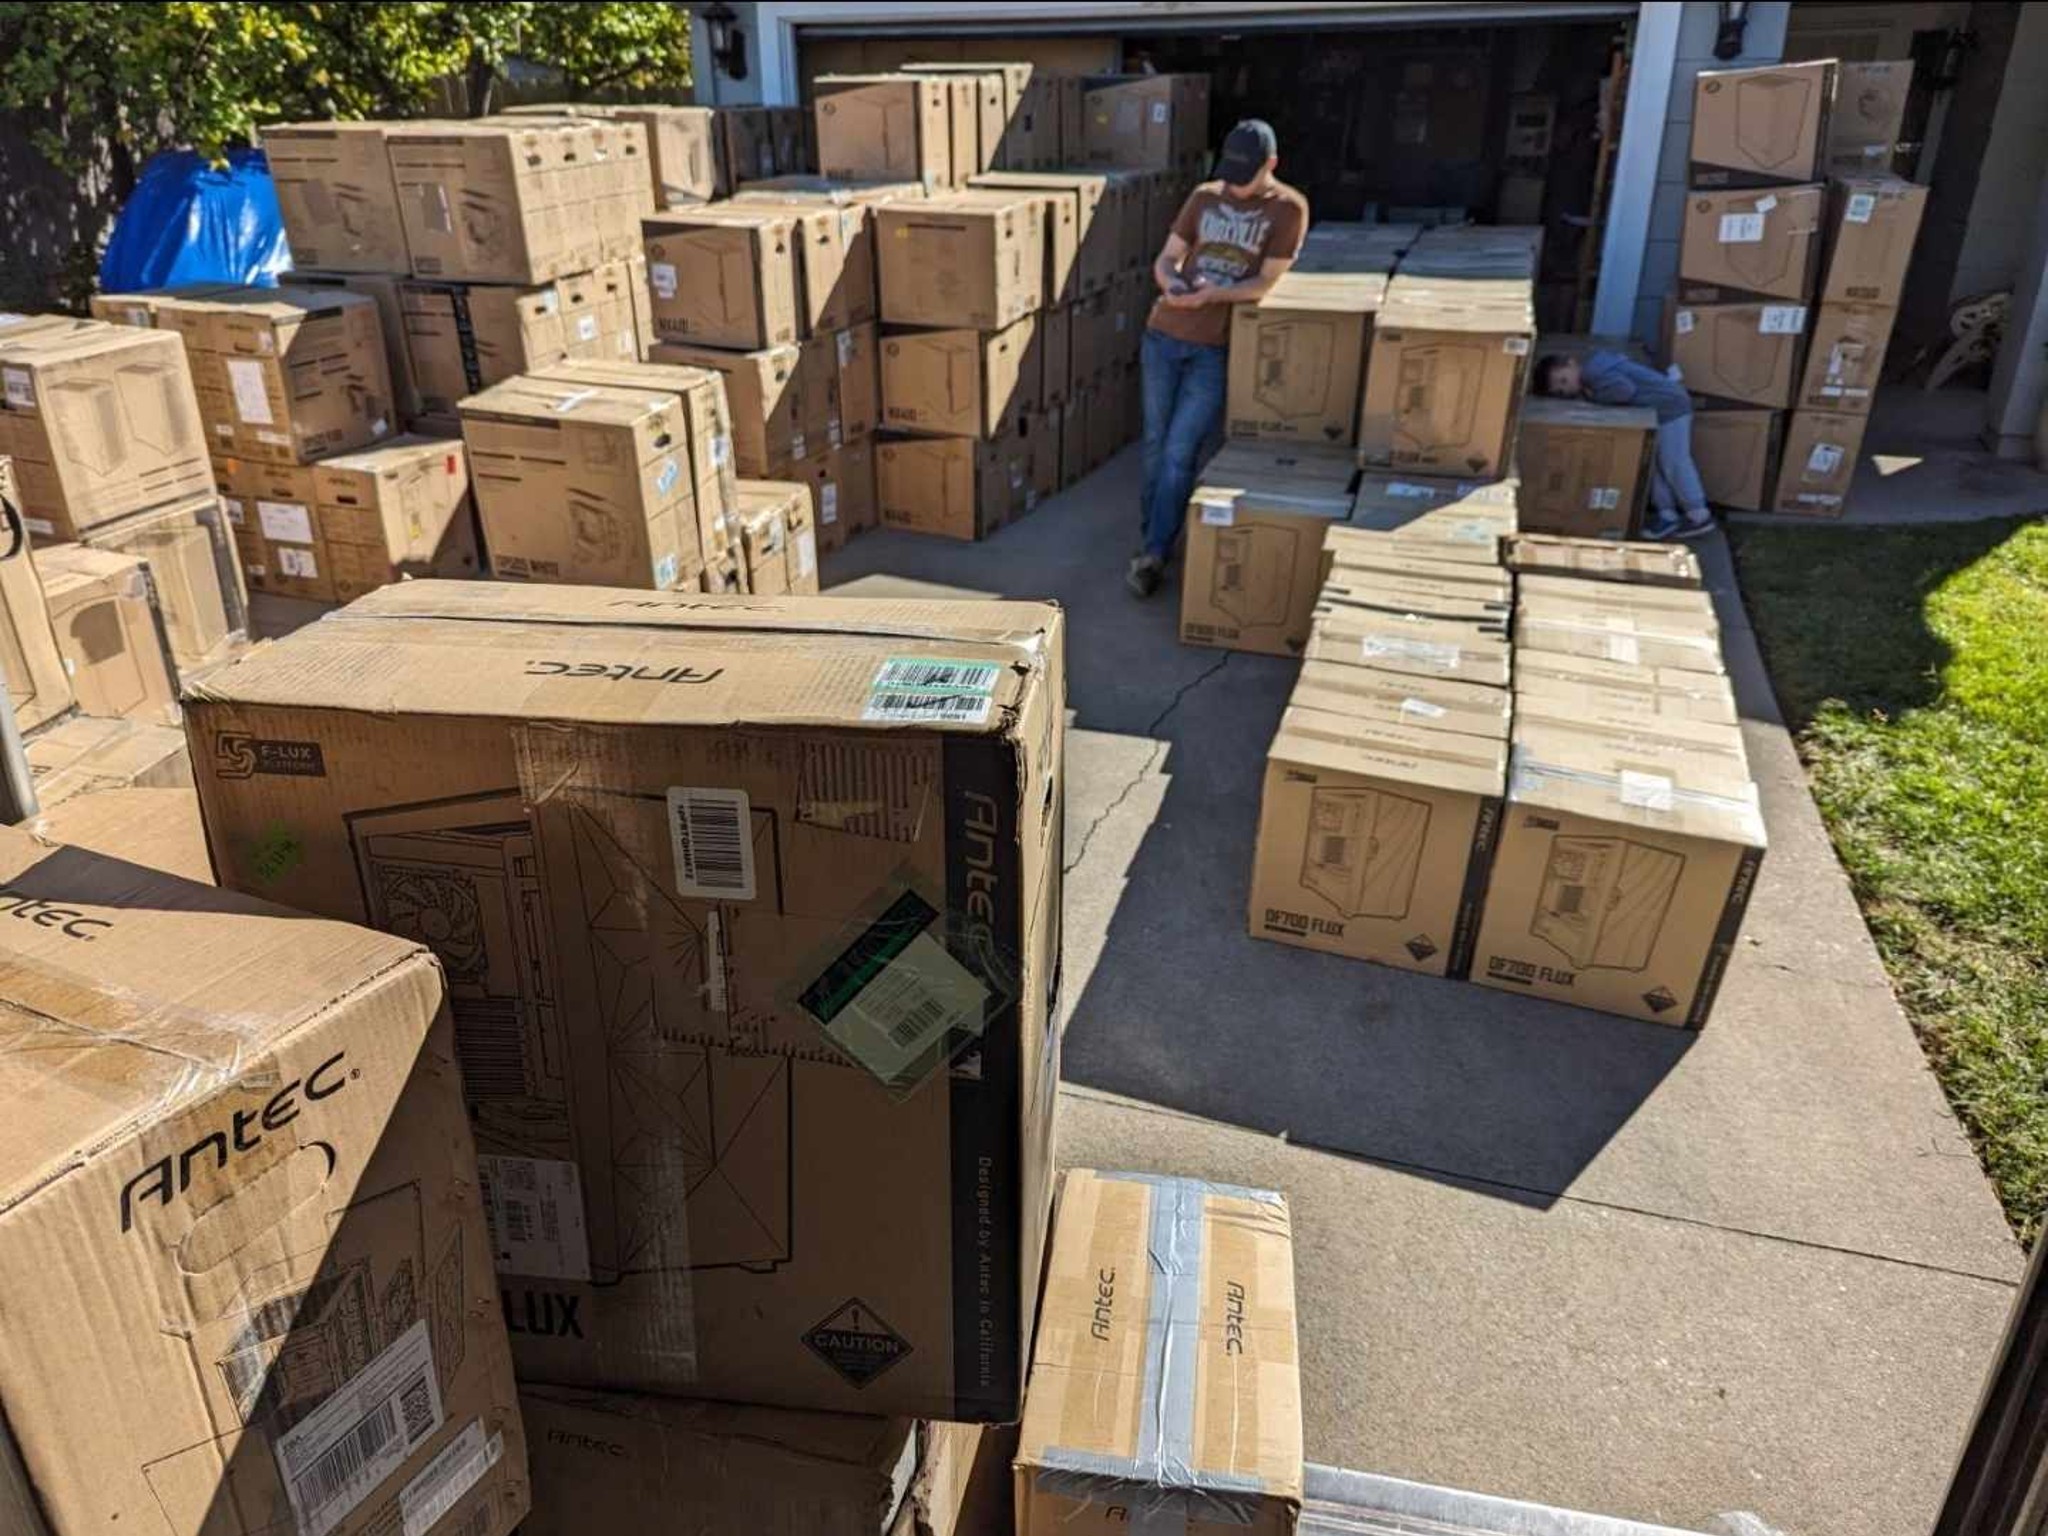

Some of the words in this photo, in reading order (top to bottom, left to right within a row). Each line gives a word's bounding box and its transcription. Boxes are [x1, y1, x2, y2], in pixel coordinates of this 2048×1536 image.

[523, 660, 725, 684] Antec
[963, 789, 998, 956] Antec
[1312, 918, 1345, 937] FLUX
[1540, 966, 1575, 986] FLUX
[118, 1049, 346, 1235] Antec
[500, 1289, 584, 1340] LUX
[1090, 1264, 1115, 1342] Antec
[1226, 1280, 1246, 1356] Antec
[814, 1333, 899, 1354] CAUTION
